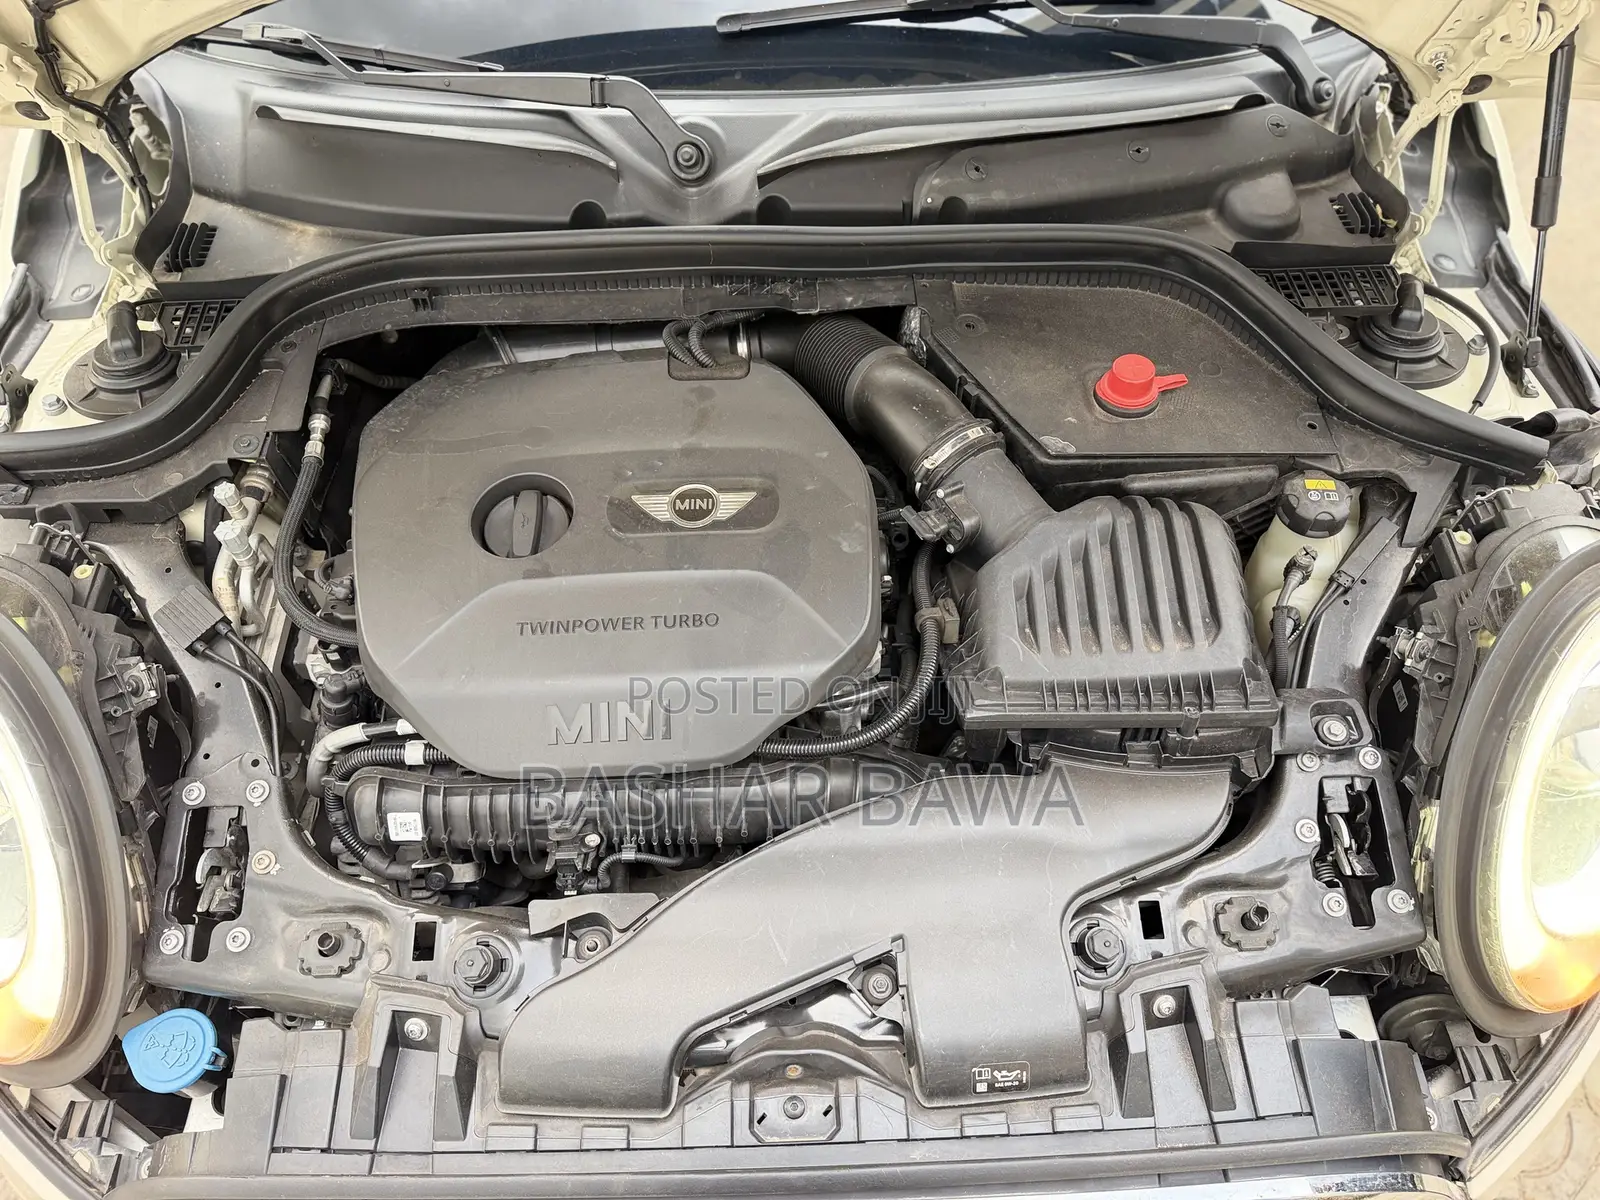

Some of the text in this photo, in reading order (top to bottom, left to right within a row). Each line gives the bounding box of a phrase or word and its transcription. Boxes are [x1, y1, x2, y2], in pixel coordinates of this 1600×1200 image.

[675, 498, 713, 511] MINI
[516, 612, 720, 636] TWINPOWER TURBO
[547, 699, 672, 746] MINI
